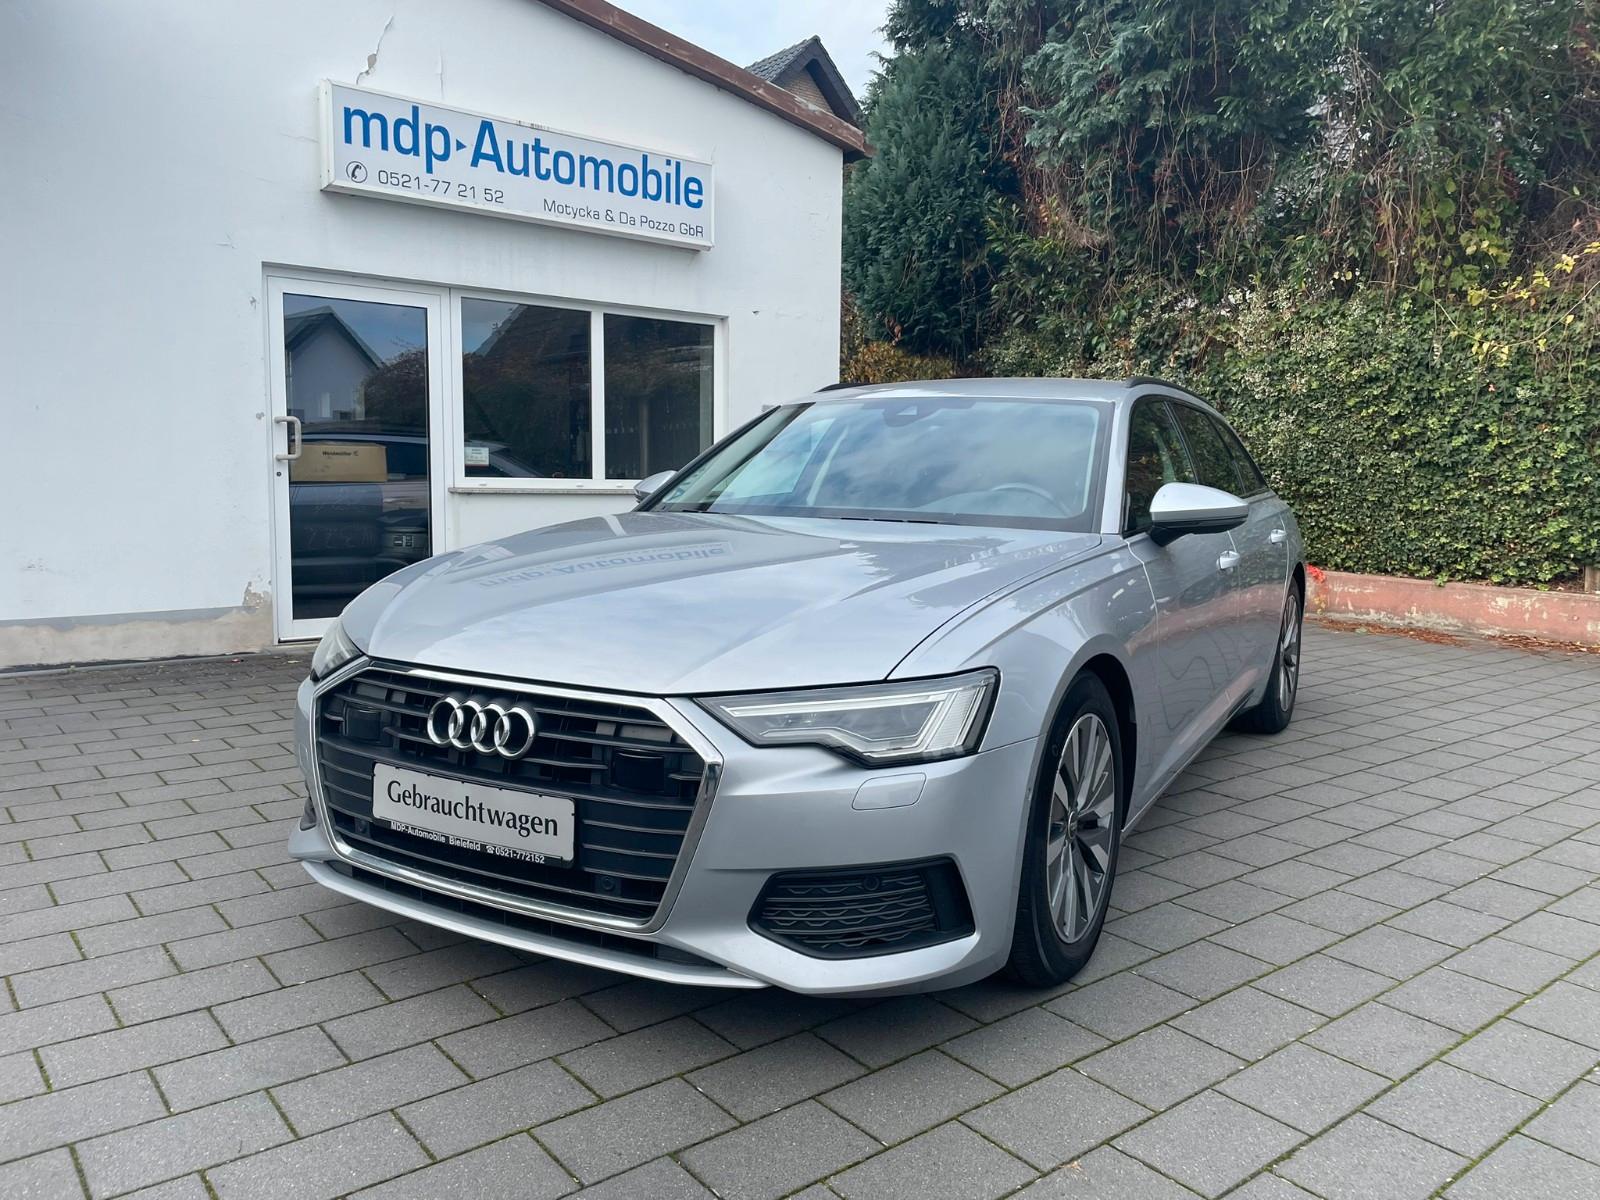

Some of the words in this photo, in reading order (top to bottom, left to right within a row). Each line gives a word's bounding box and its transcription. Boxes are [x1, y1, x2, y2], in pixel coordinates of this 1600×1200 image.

[378, 169, 451, 196] 0521-77
[457, 183, 477, 200] 21
[484, 187, 505, 205] 52
[543, 198, 601, 219] Motycka
[604, 209, 616, 223] &
[619, 211, 636, 226] Da
[640, 215, 676, 233] Pozzo
[679, 222, 704, 238] GbR
[387, 780, 558, 838] Gebrauchtwagen
[390, 821, 446, 843] MDP-Automobile
[449, 836, 481, 851] Bielefeld
[495, 845, 545, 864] 0521-772152
